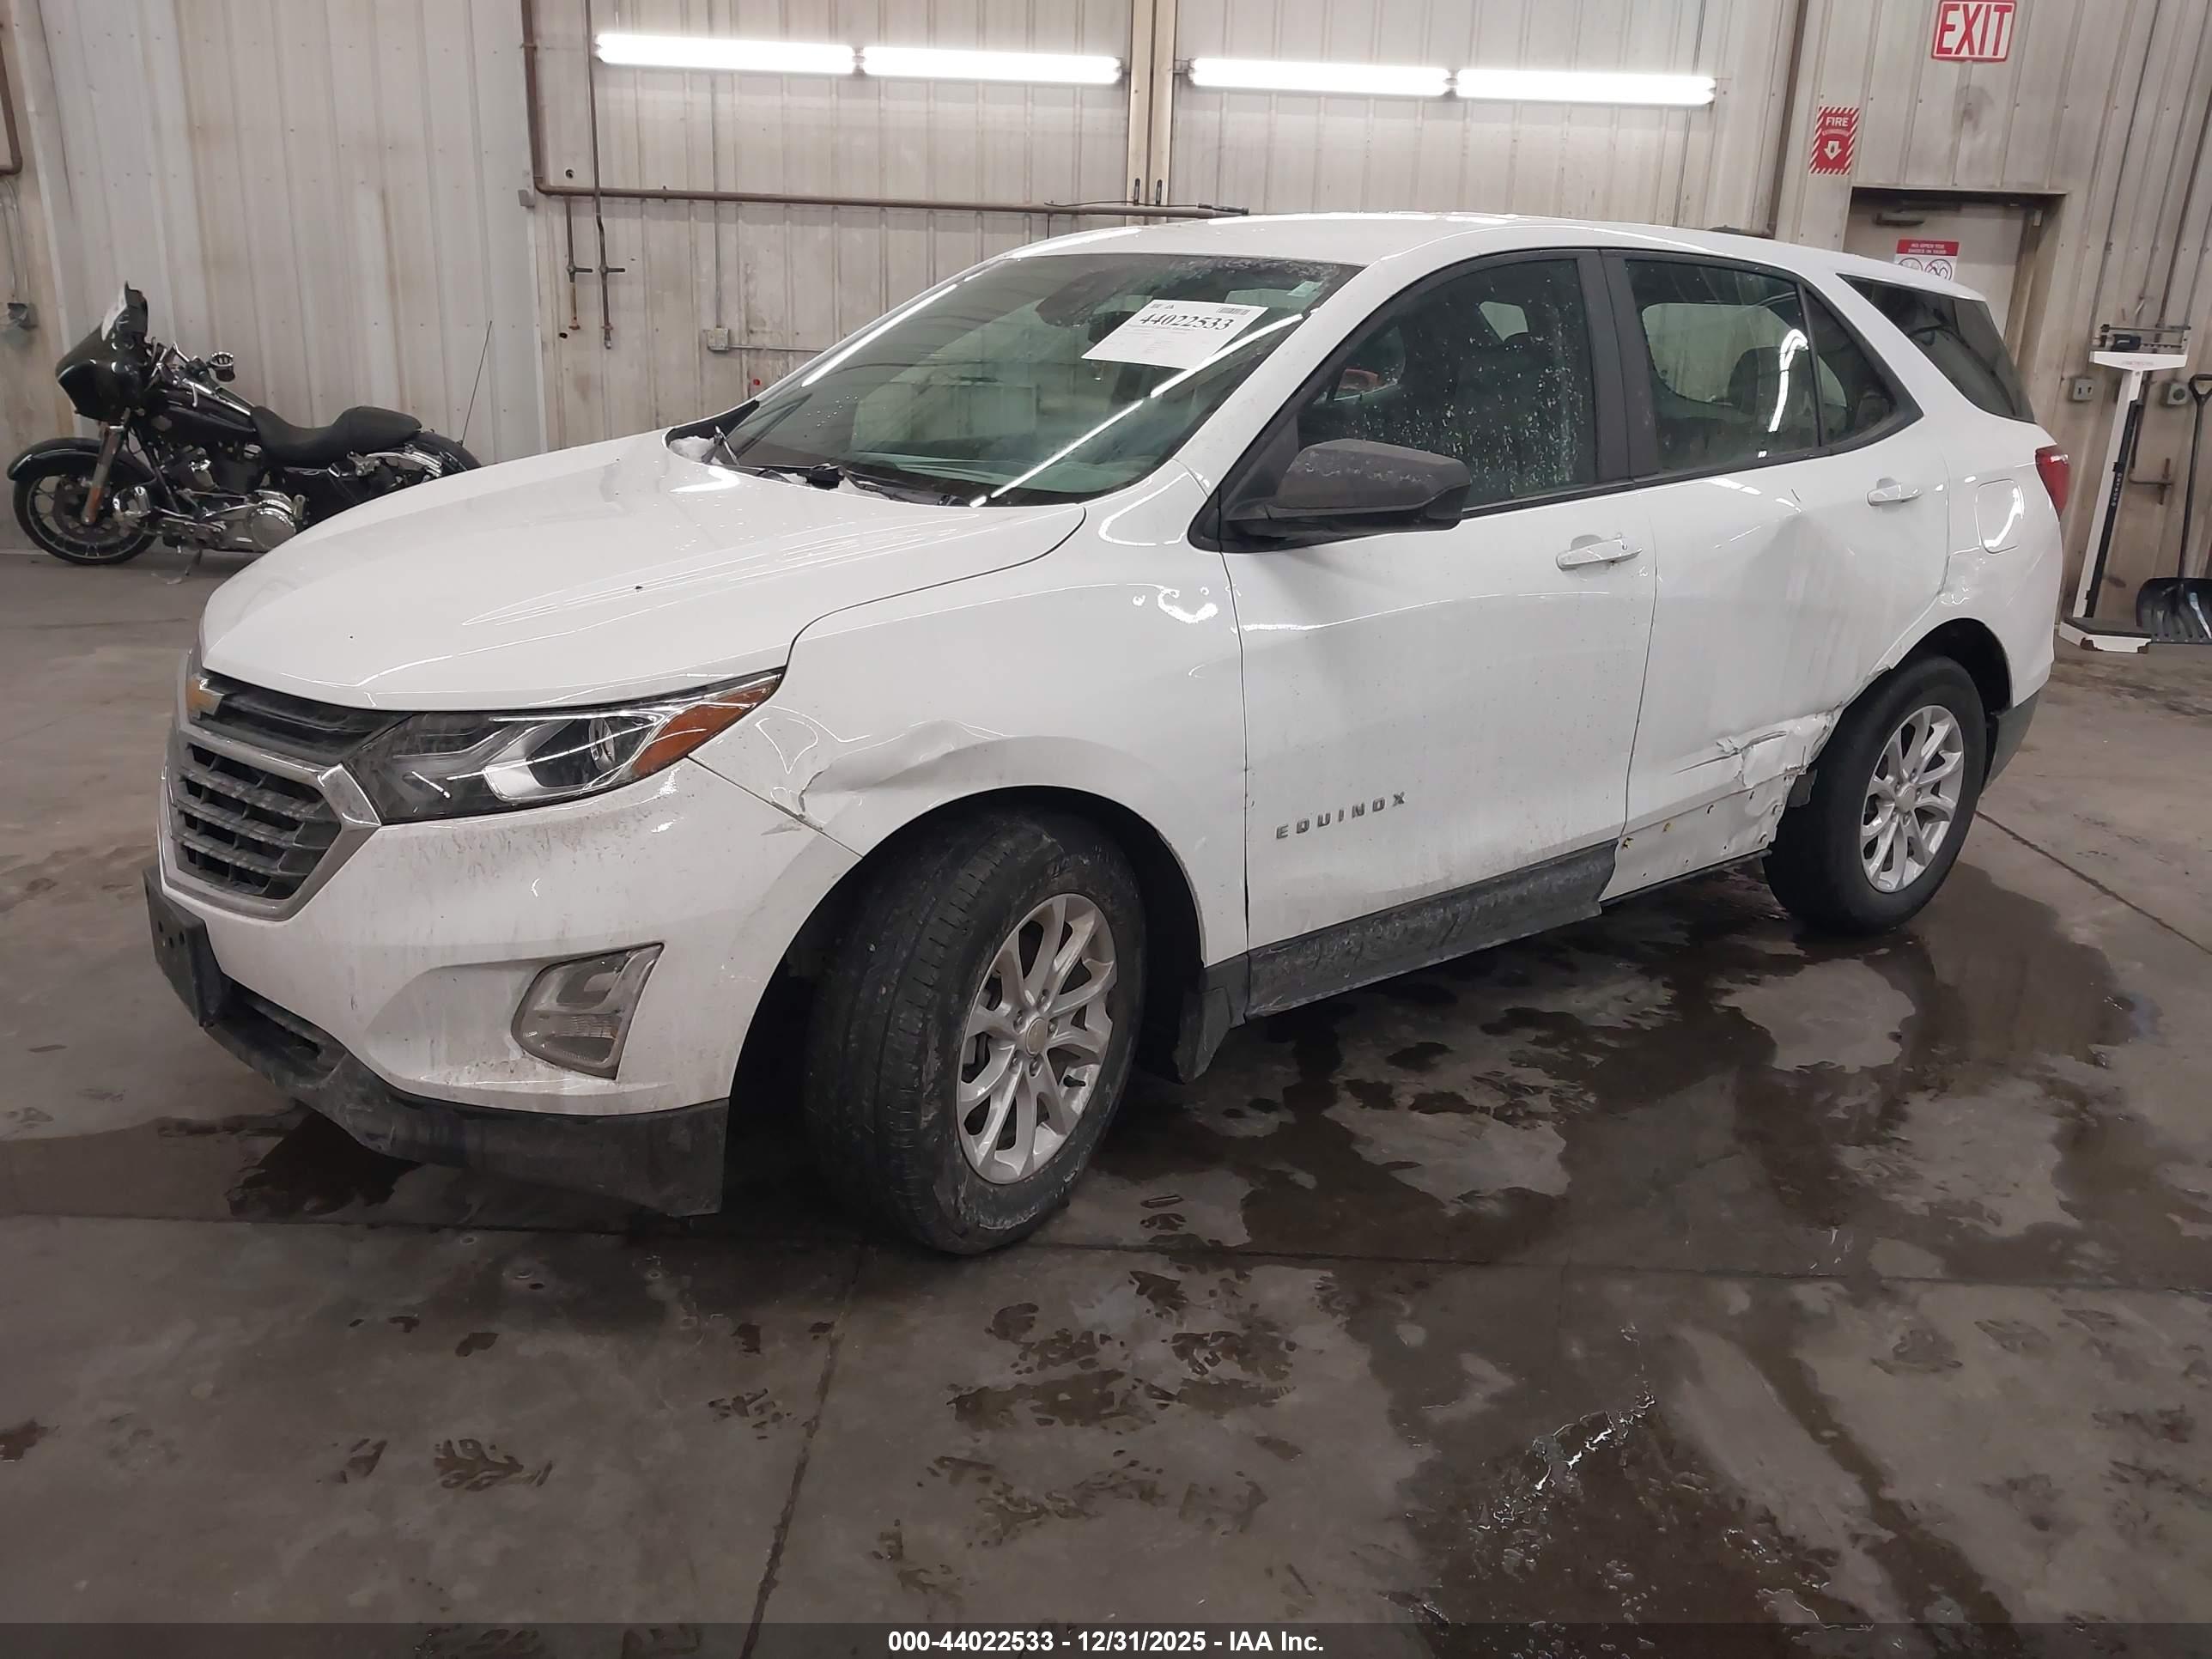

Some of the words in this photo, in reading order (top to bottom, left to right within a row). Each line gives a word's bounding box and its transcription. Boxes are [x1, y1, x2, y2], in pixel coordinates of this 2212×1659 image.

[1936, 3, 2014, 57] EXIT
[1826, 116, 1850, 127] FIRE
[1139, 313, 1234, 331] 44022533
[1275, 791, 1406, 840] EQUINOX
